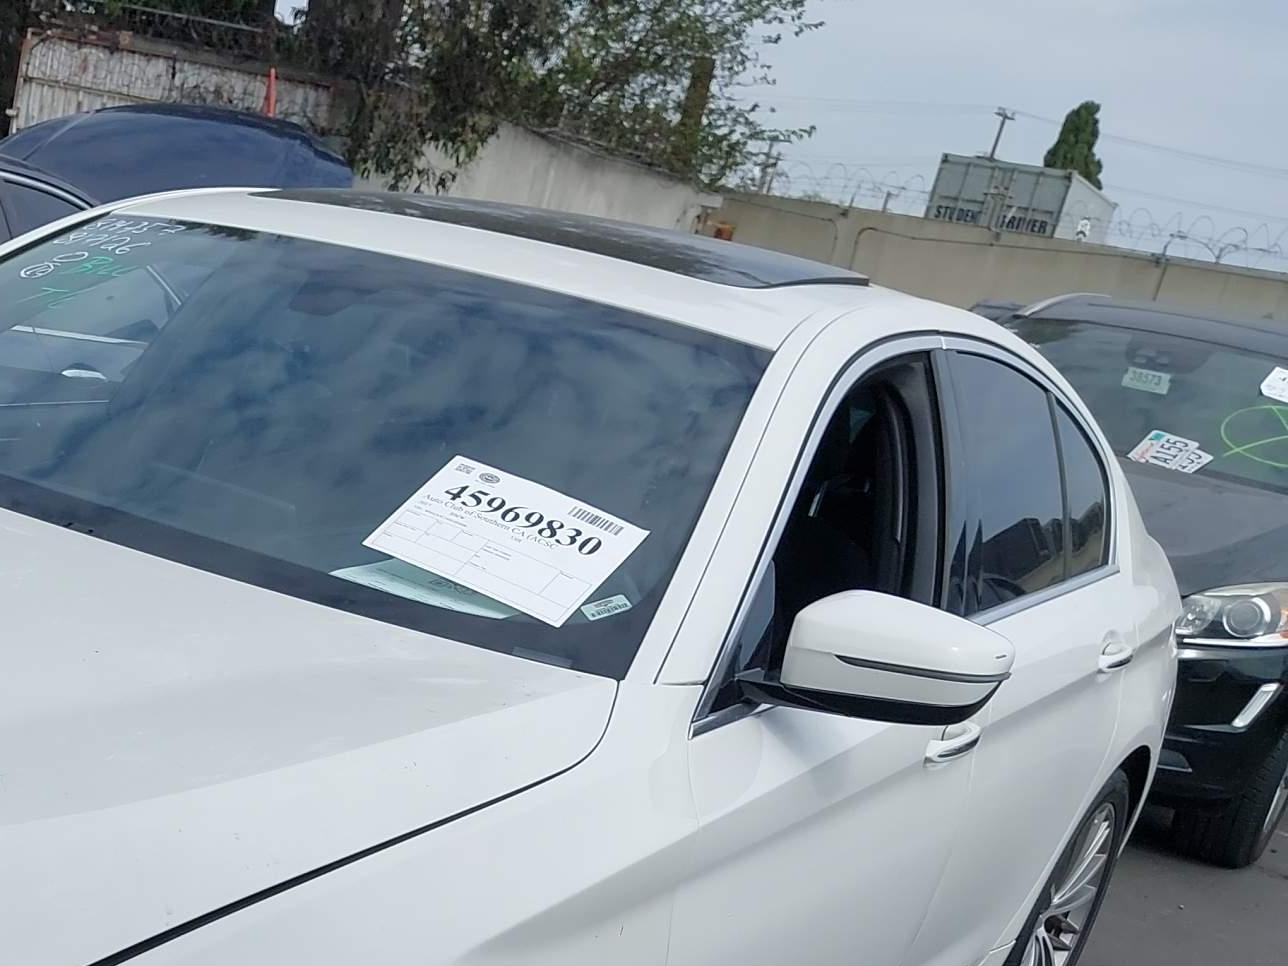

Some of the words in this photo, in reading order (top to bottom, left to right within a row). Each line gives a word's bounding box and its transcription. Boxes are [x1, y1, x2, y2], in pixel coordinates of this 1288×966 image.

[424, 494, 443, 505] Auto
[444, 500, 464, 513] Club
[474, 511, 510, 531] Southern
[444, 485, 602, 556] 45969830
